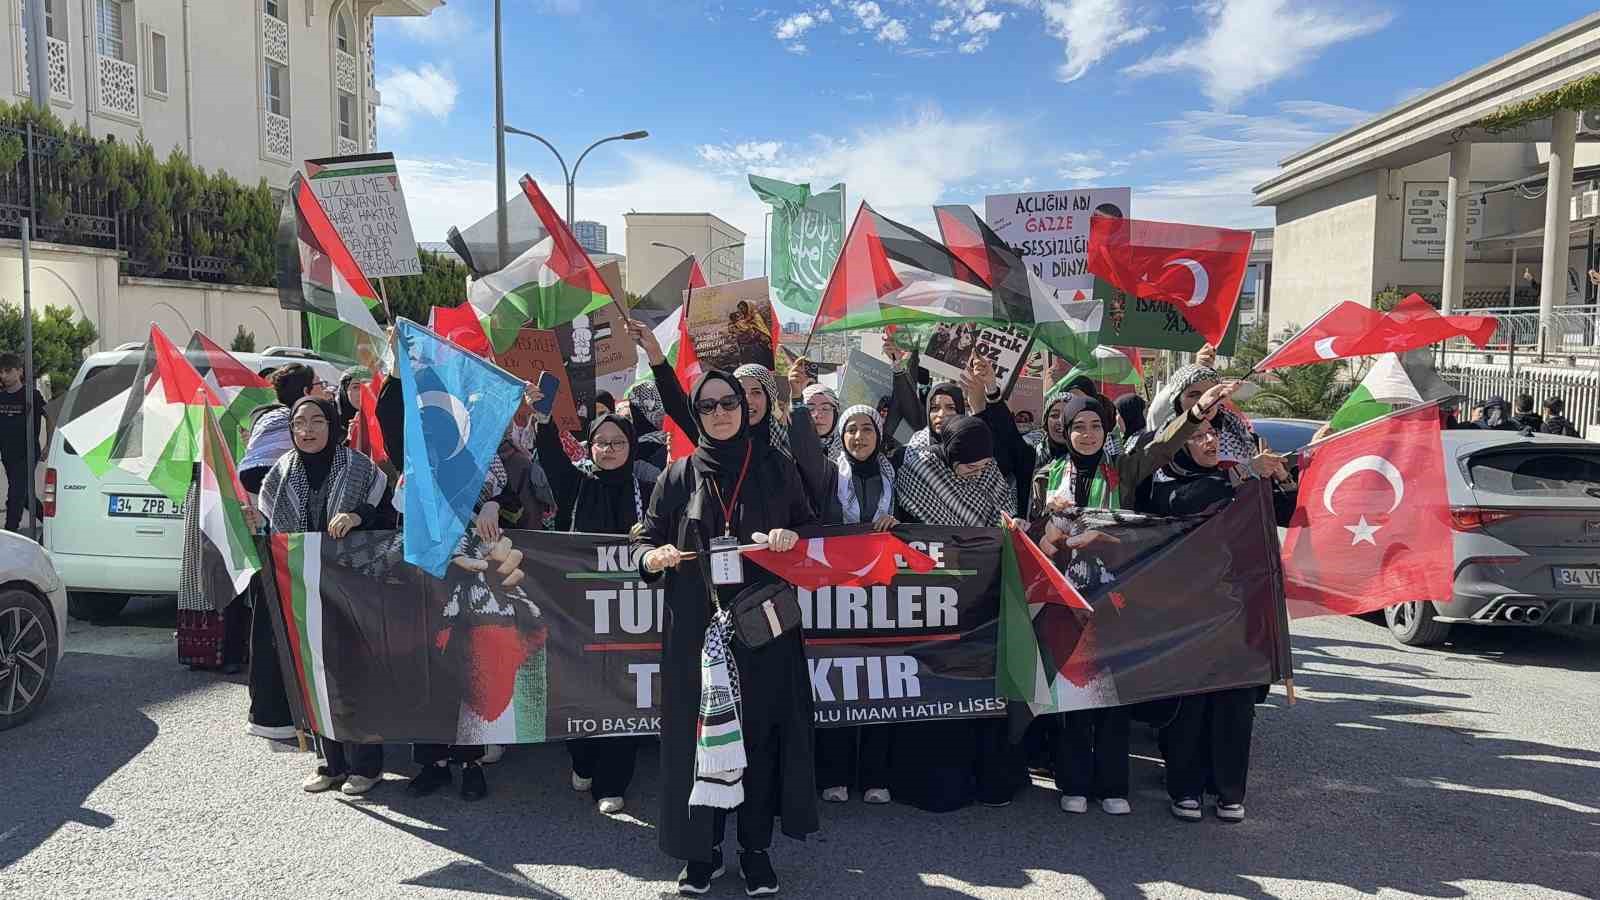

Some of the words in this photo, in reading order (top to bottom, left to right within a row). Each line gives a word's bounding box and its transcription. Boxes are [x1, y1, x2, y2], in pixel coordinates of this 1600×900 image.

[1015, 194, 1068, 217] AÇLIĞIN
[1072, 192, 1091, 211] ADI
[1025, 215, 1073, 232] GAZZE
[117, 498, 132, 512] 34
[141, 498, 166, 513] ZPB
[1562, 569, 1581, 584] 34
[567, 717, 597, 733] İTO
[601, 716, 662, 735] BAŞAK
[845, 704, 897, 722] İMAM
[901, 701, 954, 719] HATİP
